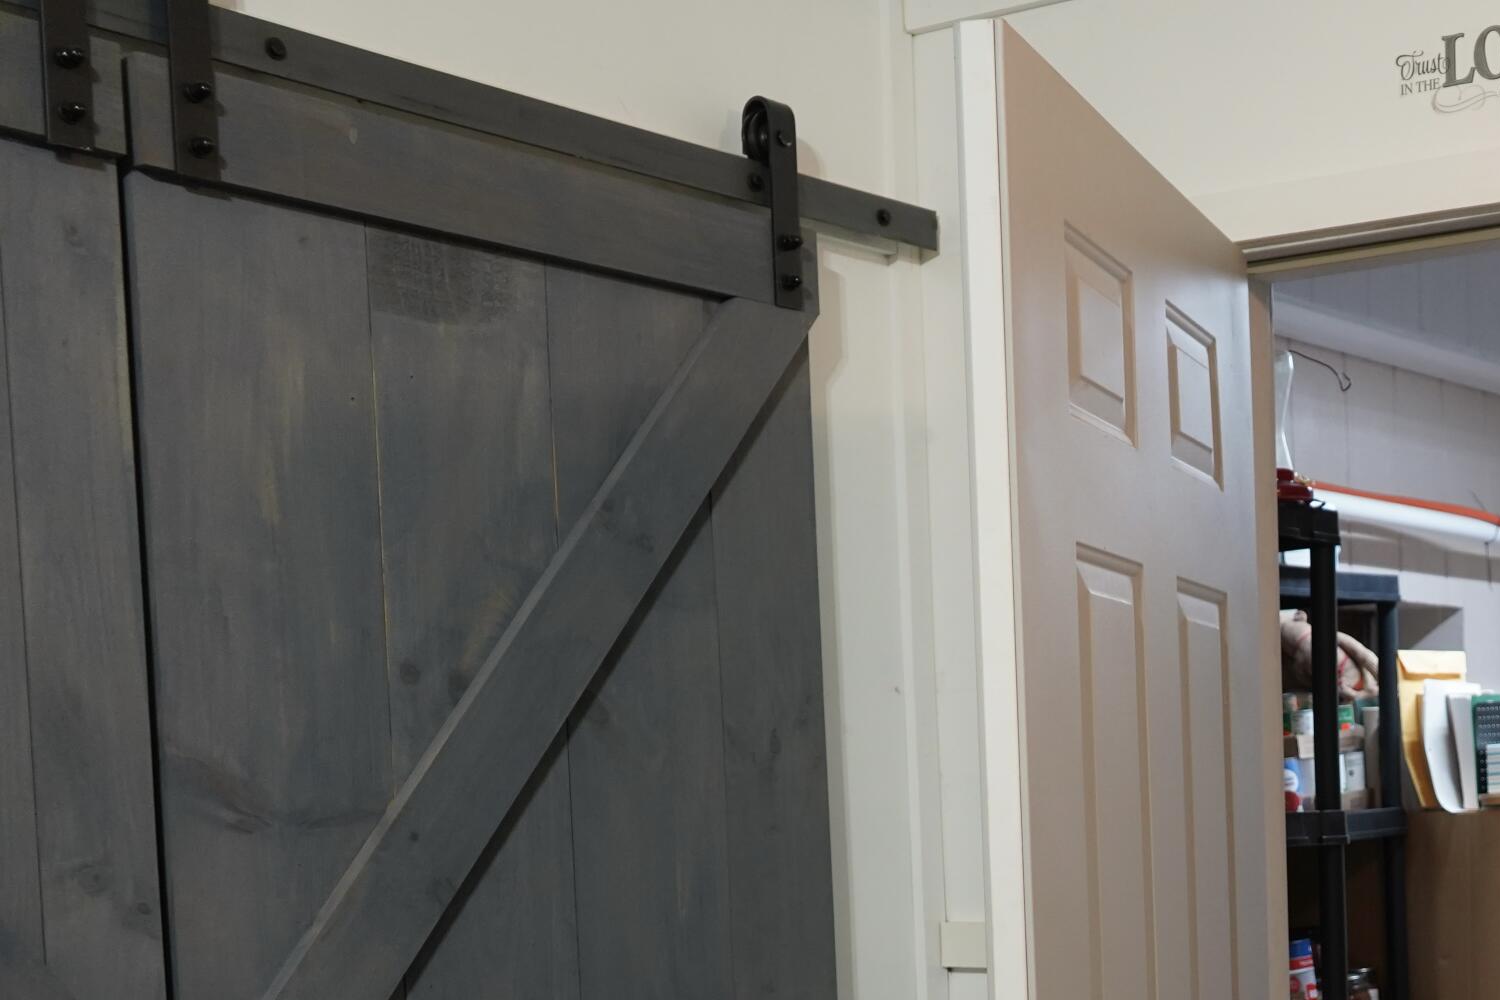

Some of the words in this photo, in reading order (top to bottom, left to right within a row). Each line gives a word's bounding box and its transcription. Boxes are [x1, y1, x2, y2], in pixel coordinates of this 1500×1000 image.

[1396, 49, 1449, 80] Trust
[1400, 83, 1413, 96] IN
[1415, 78, 1441, 93] THE
